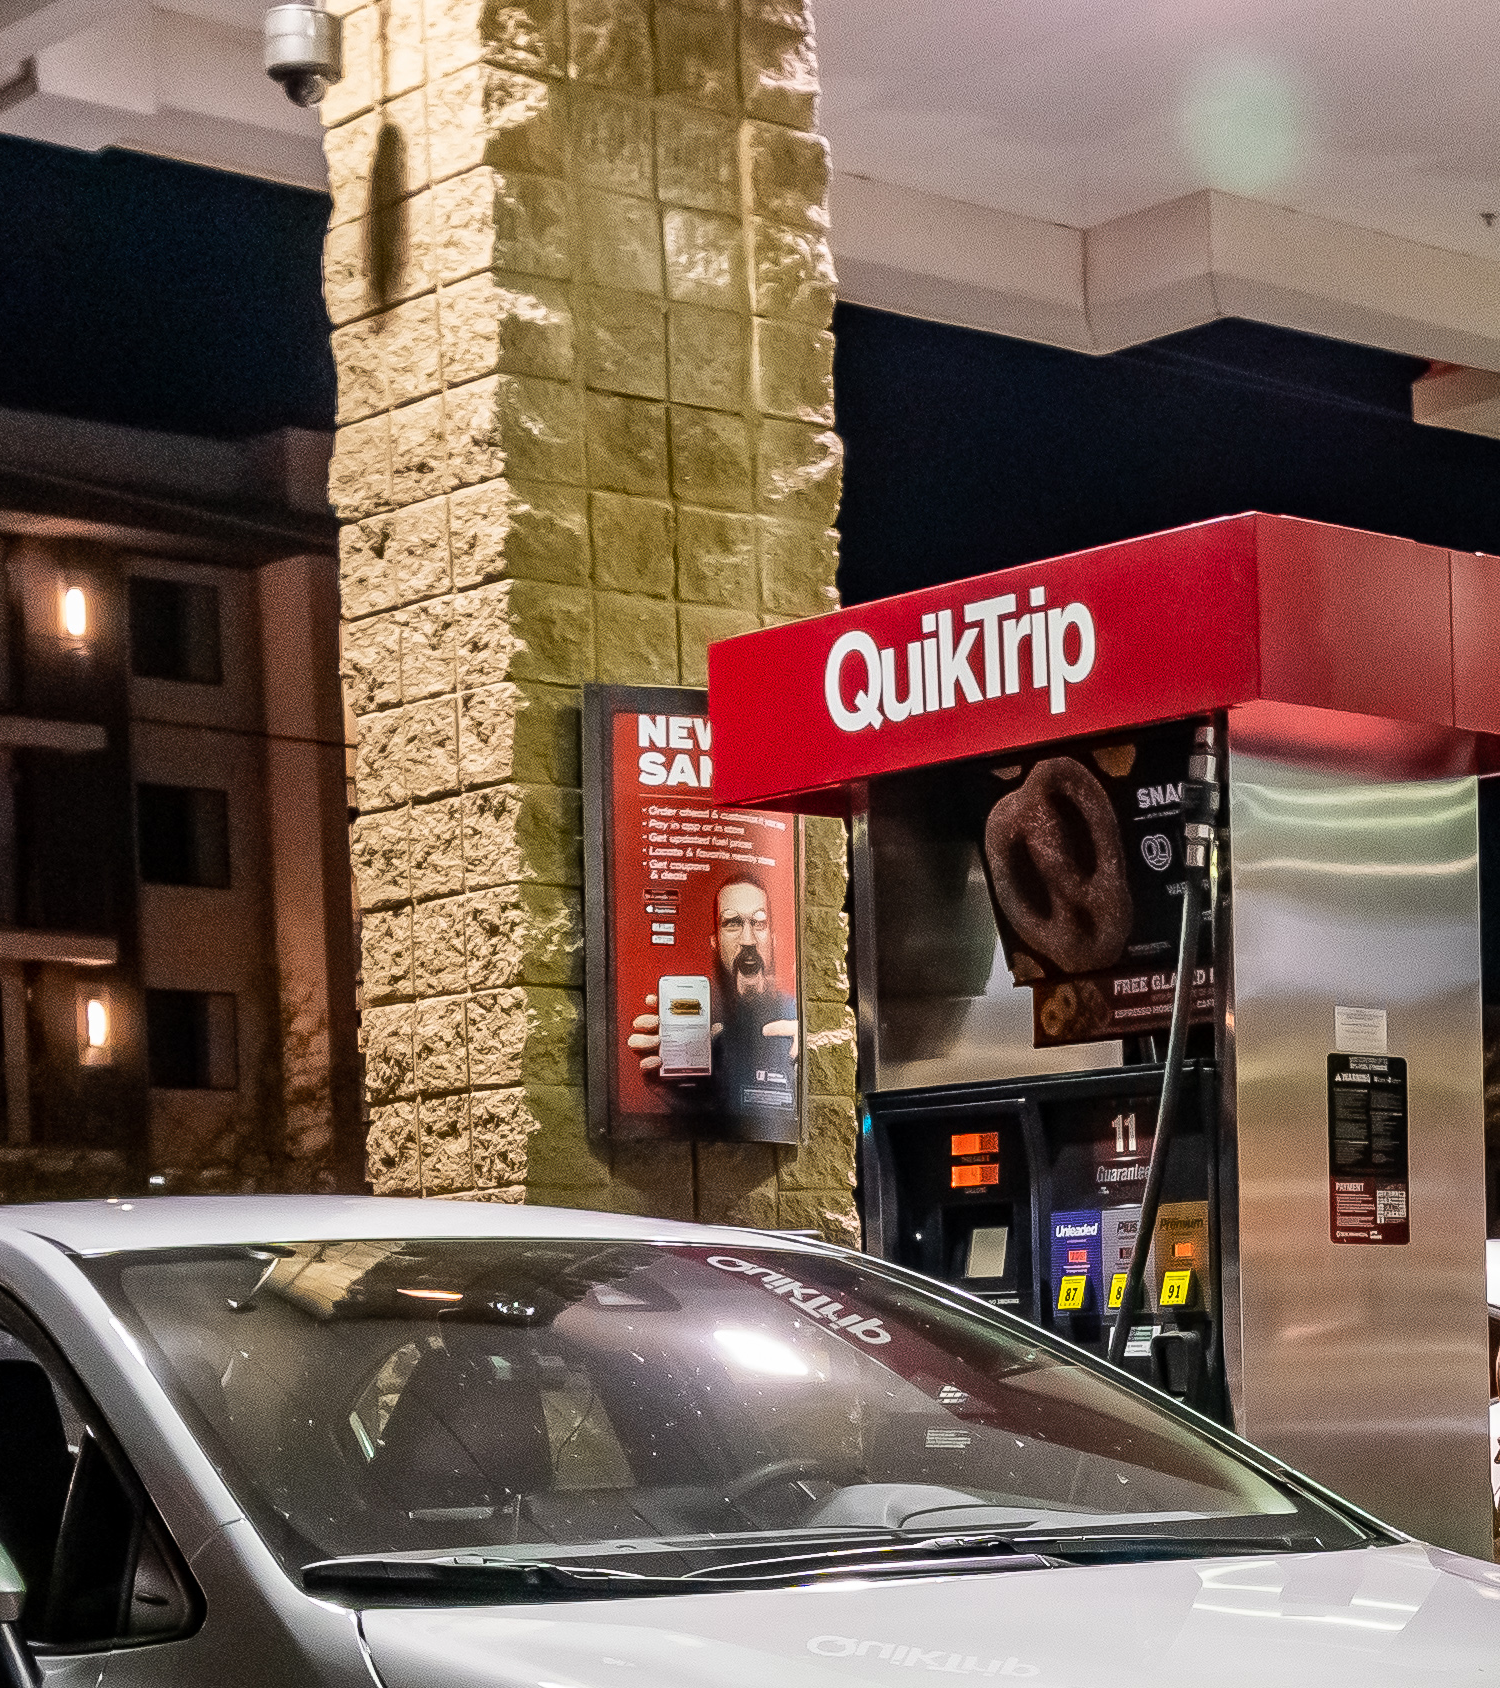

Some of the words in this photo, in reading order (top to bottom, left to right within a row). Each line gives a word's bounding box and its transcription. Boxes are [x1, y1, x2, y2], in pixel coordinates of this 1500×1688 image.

[824, 585, 1096, 734] QuikTrip
[1113, 976, 1148, 996] FREE
[1112, 1113, 1137, 1152] 11
[1055, 1222, 1099, 1238] Unleaded
[1065, 1287, 1078, 1302] 87
[1168, 1284, 1181, 1299] 91
